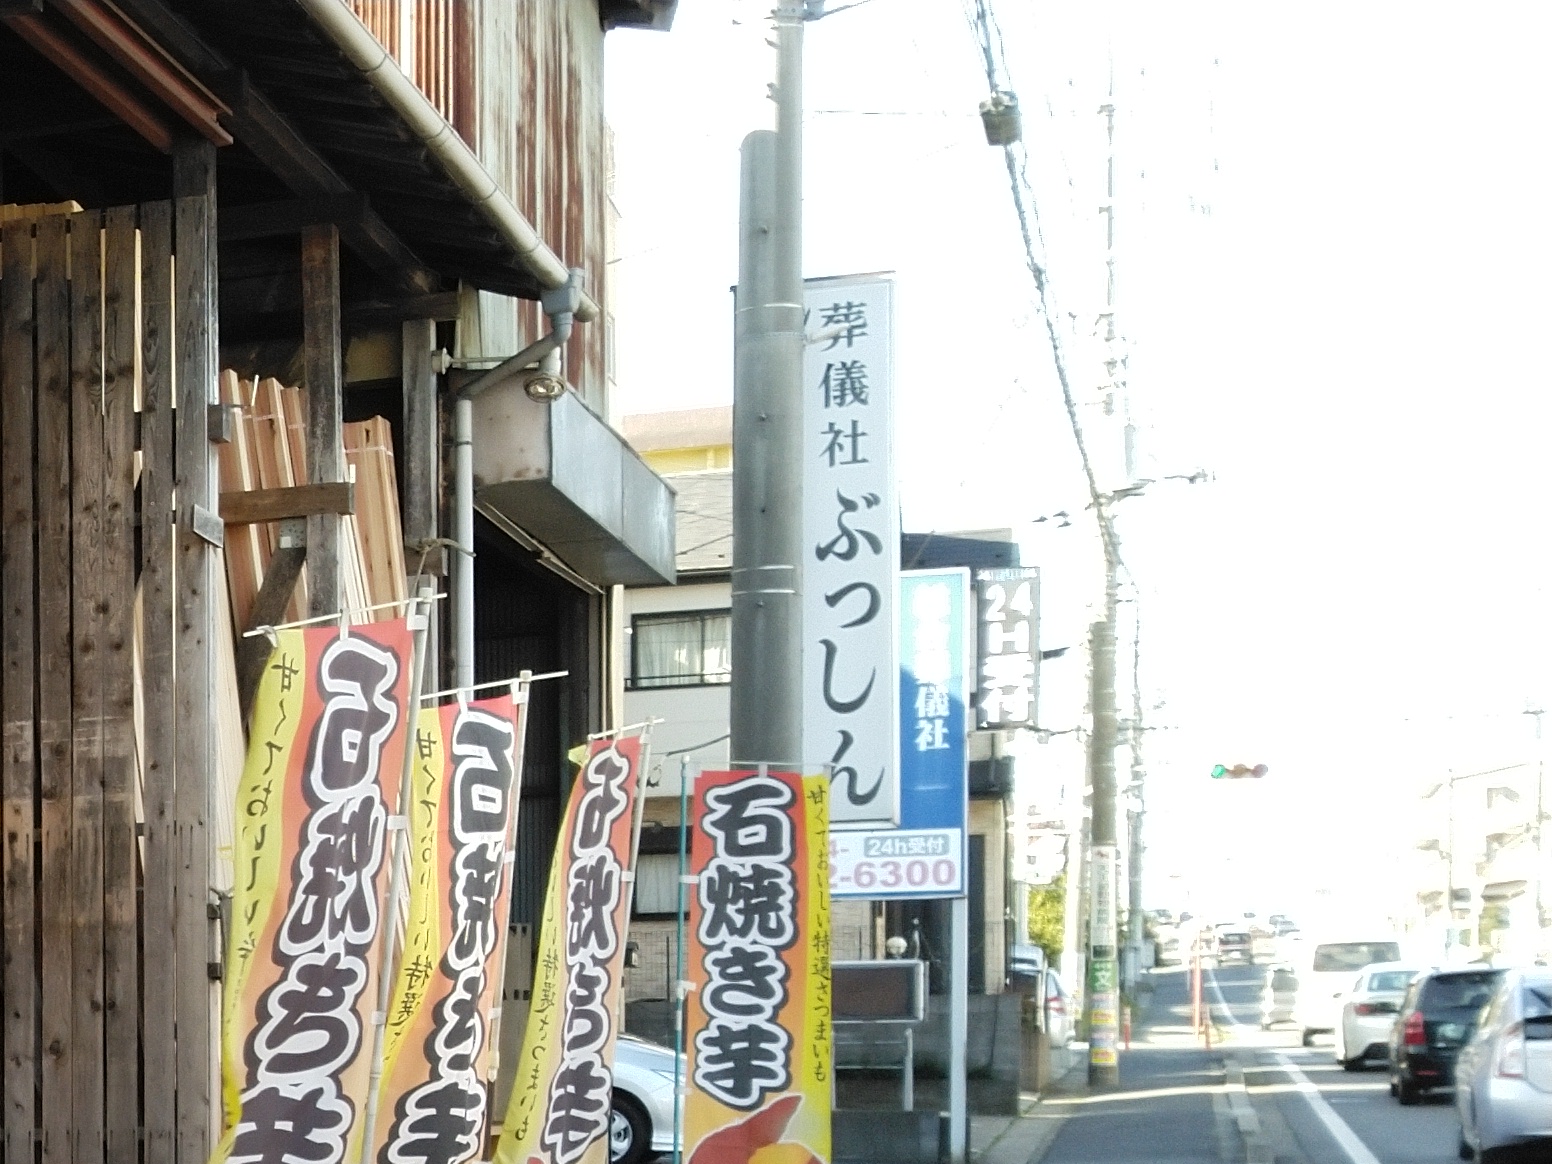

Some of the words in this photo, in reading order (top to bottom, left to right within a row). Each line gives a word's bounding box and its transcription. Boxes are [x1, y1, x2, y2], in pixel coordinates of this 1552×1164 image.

[817, 301, 871, 467] 葬儀社
[814, 487, 884, 807] ぶっしん
[699, 780, 789, 1103] 石焼き芋
[806, 785, 832, 1083] 甘くておいしい特選さつまいも
[868, 837, 945, 856] 24h受付
